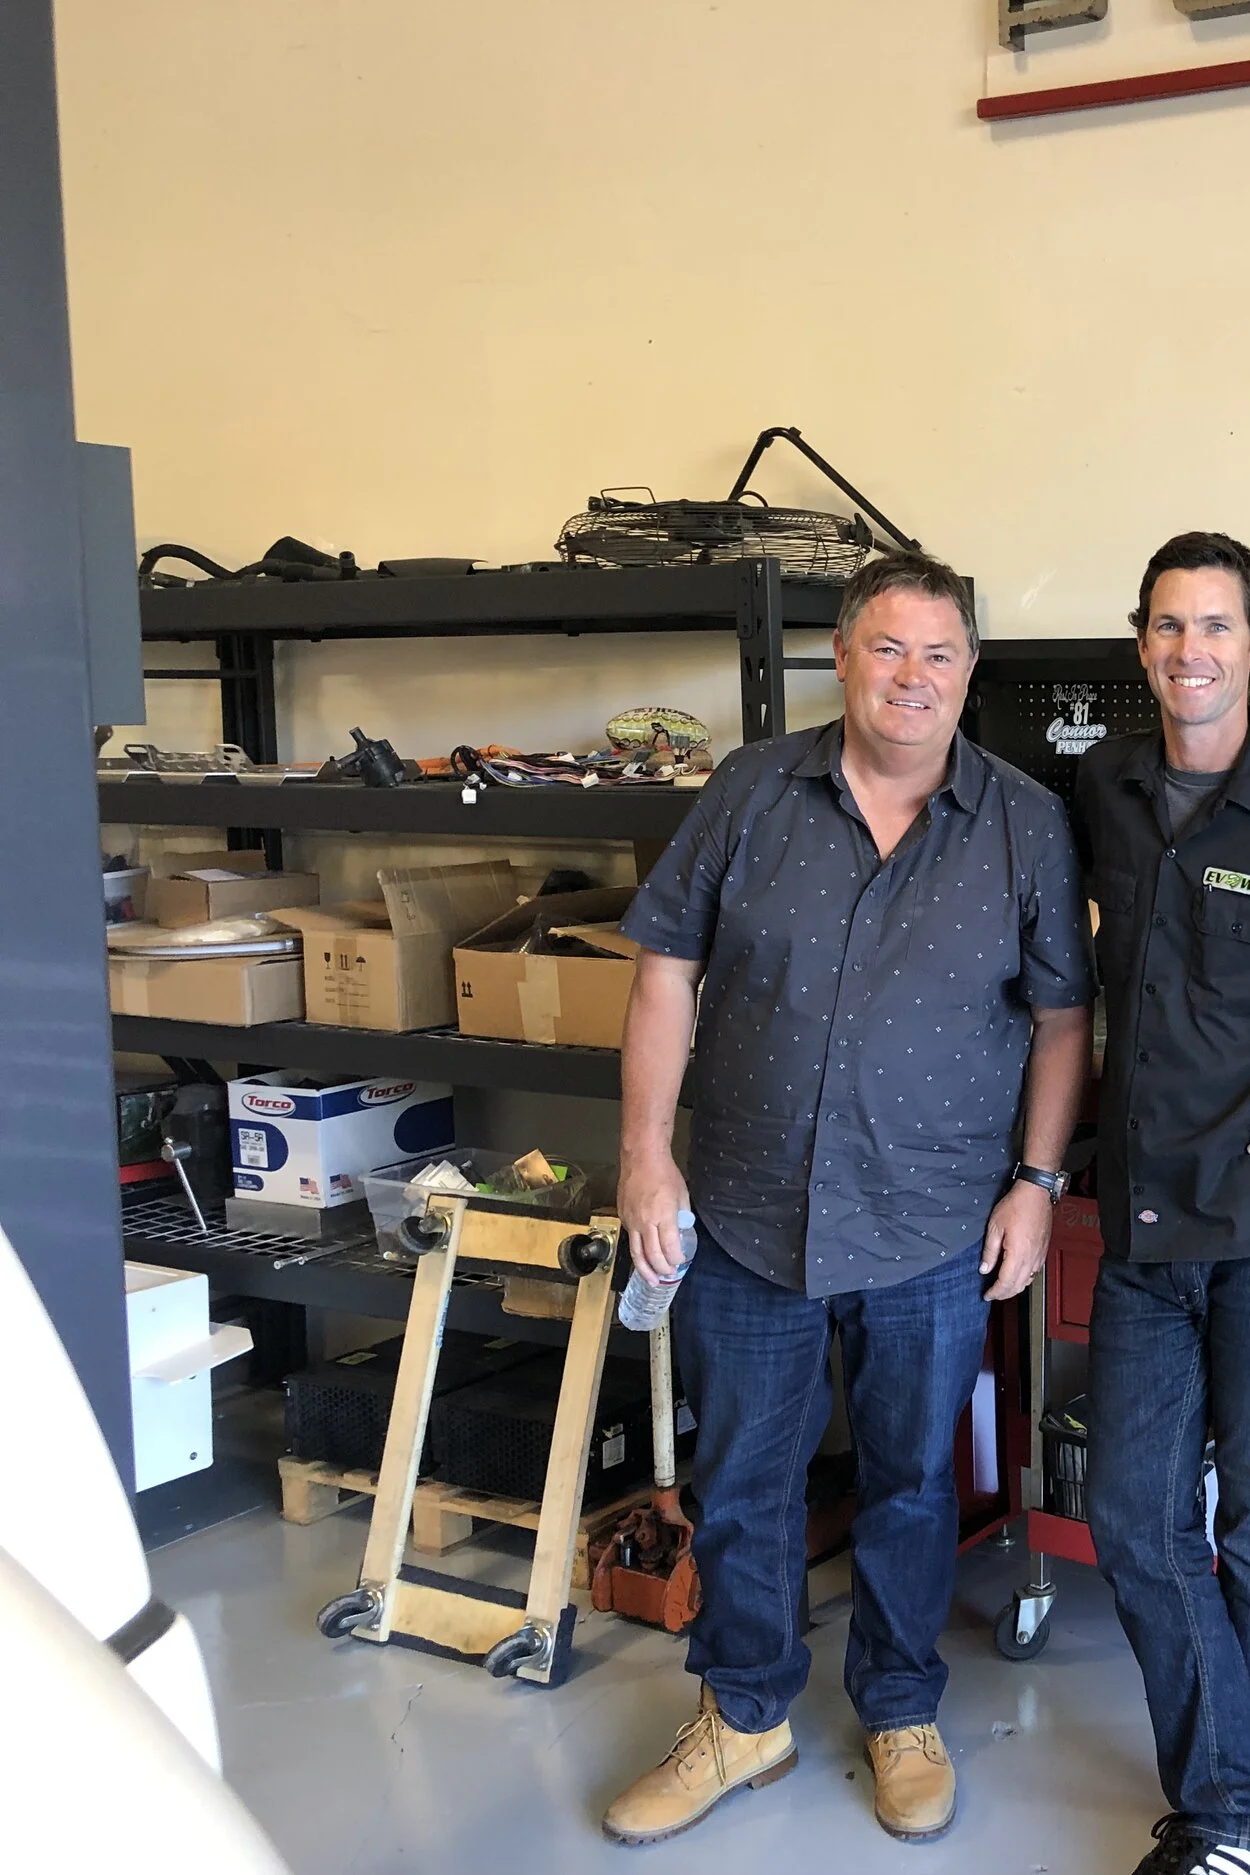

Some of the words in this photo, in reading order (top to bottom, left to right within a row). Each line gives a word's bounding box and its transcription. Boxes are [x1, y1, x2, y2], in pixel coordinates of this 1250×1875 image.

[1046, 717, 1107, 742] Connor
[366, 1082, 414, 1099] Torco
[248, 1095, 292, 1109] Torco
